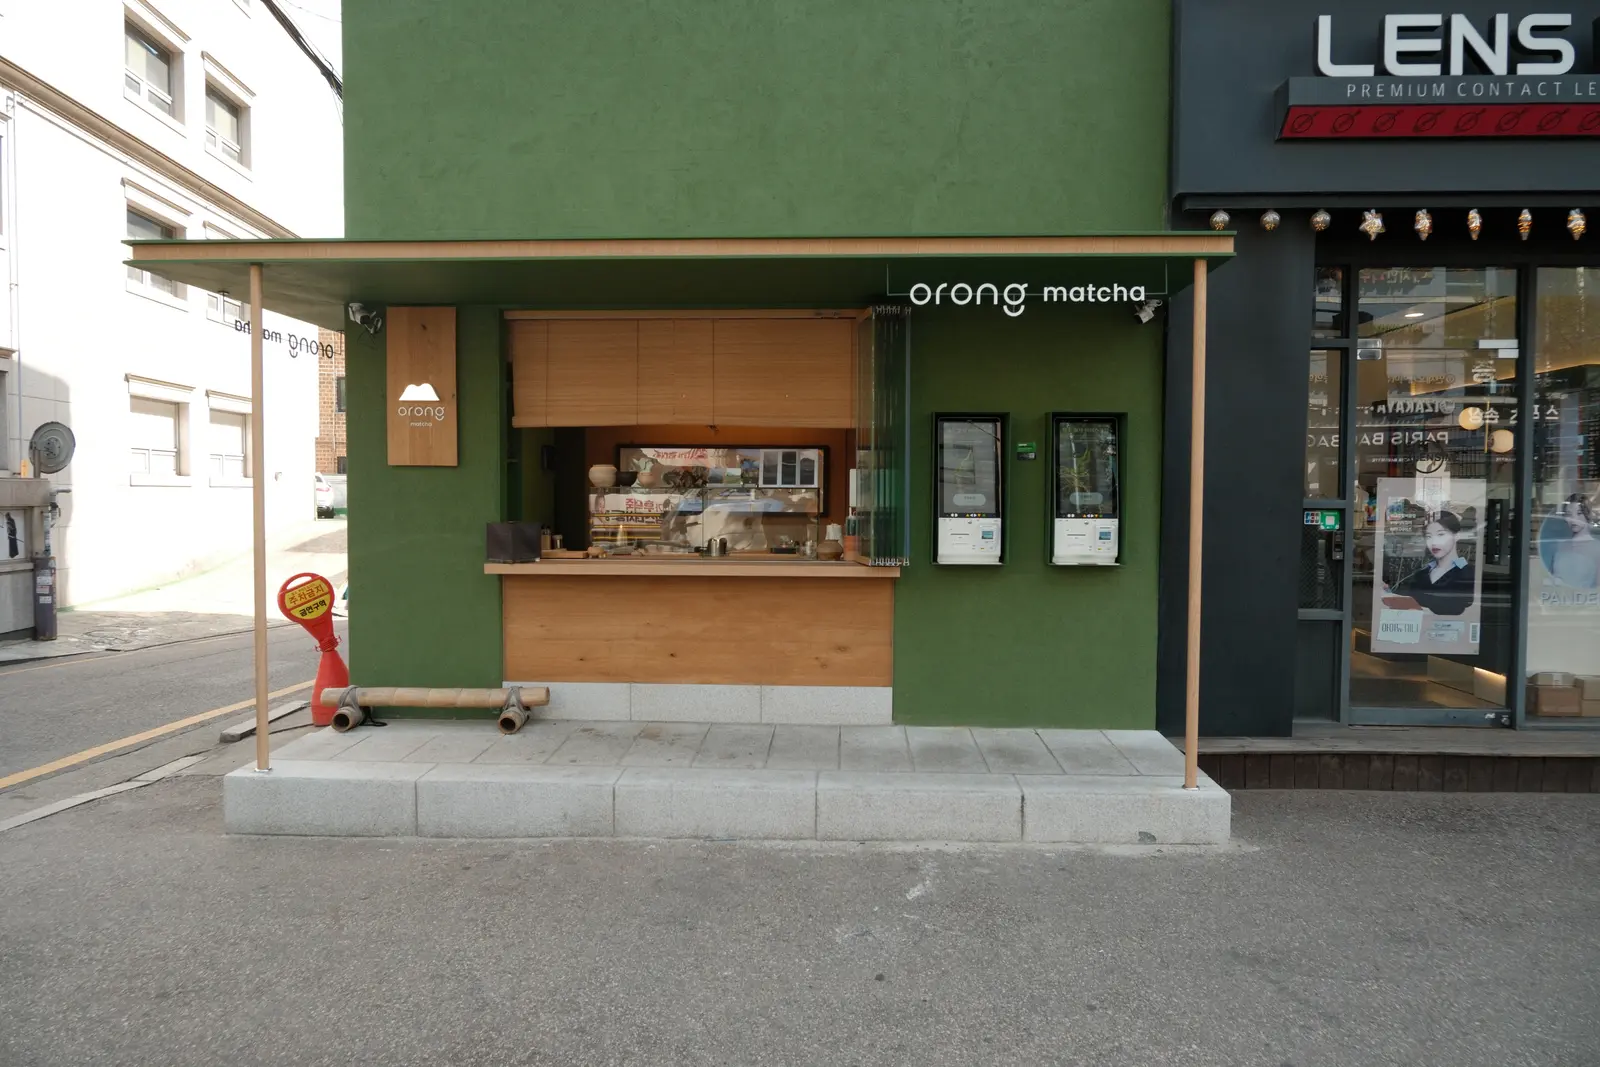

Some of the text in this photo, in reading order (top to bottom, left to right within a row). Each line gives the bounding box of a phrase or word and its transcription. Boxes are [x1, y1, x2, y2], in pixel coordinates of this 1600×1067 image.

[1317, 13, 1575, 77] LENS
[1347, 83, 1446, 97] PREMIUM
[1457, 81, 1562, 97] CONTACT
[909, 283, 1145, 317] orong matcha
[397, 406, 445, 421] orong
[289, 584, 325, 605] 주차금지
[1540, 591, 1600, 607] PANDE
[299, 599, 327, 617] 금연구역
